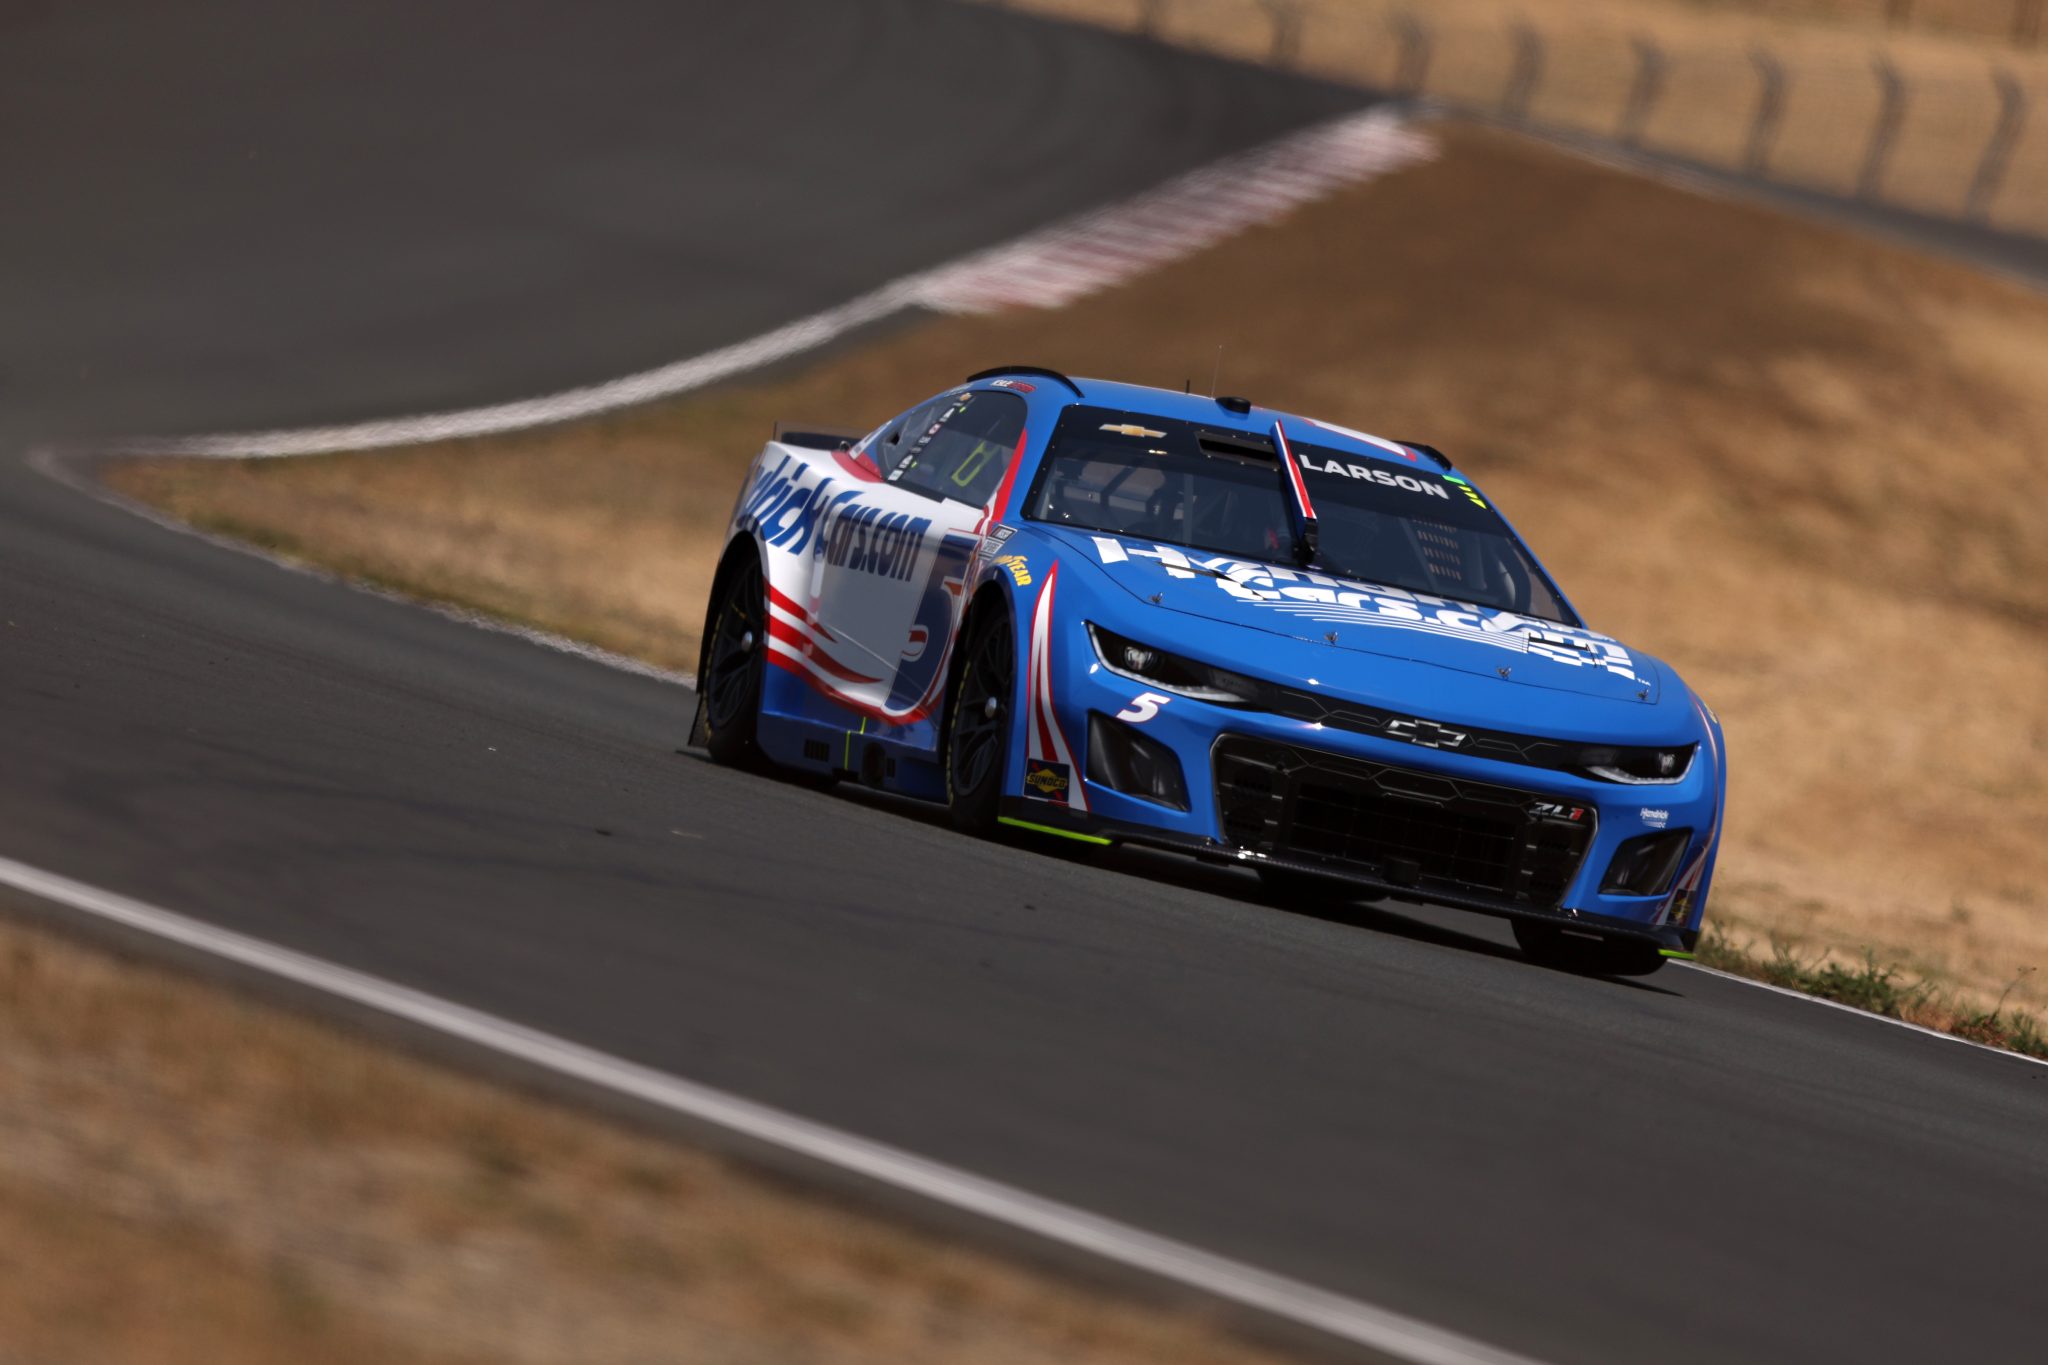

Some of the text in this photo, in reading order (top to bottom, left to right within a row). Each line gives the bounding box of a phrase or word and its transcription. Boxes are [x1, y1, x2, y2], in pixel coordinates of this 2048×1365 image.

[1299, 454, 1449, 500] LARSON
[1116, 692, 1171, 722] 5
[1529, 802, 1584, 821] ZL1
